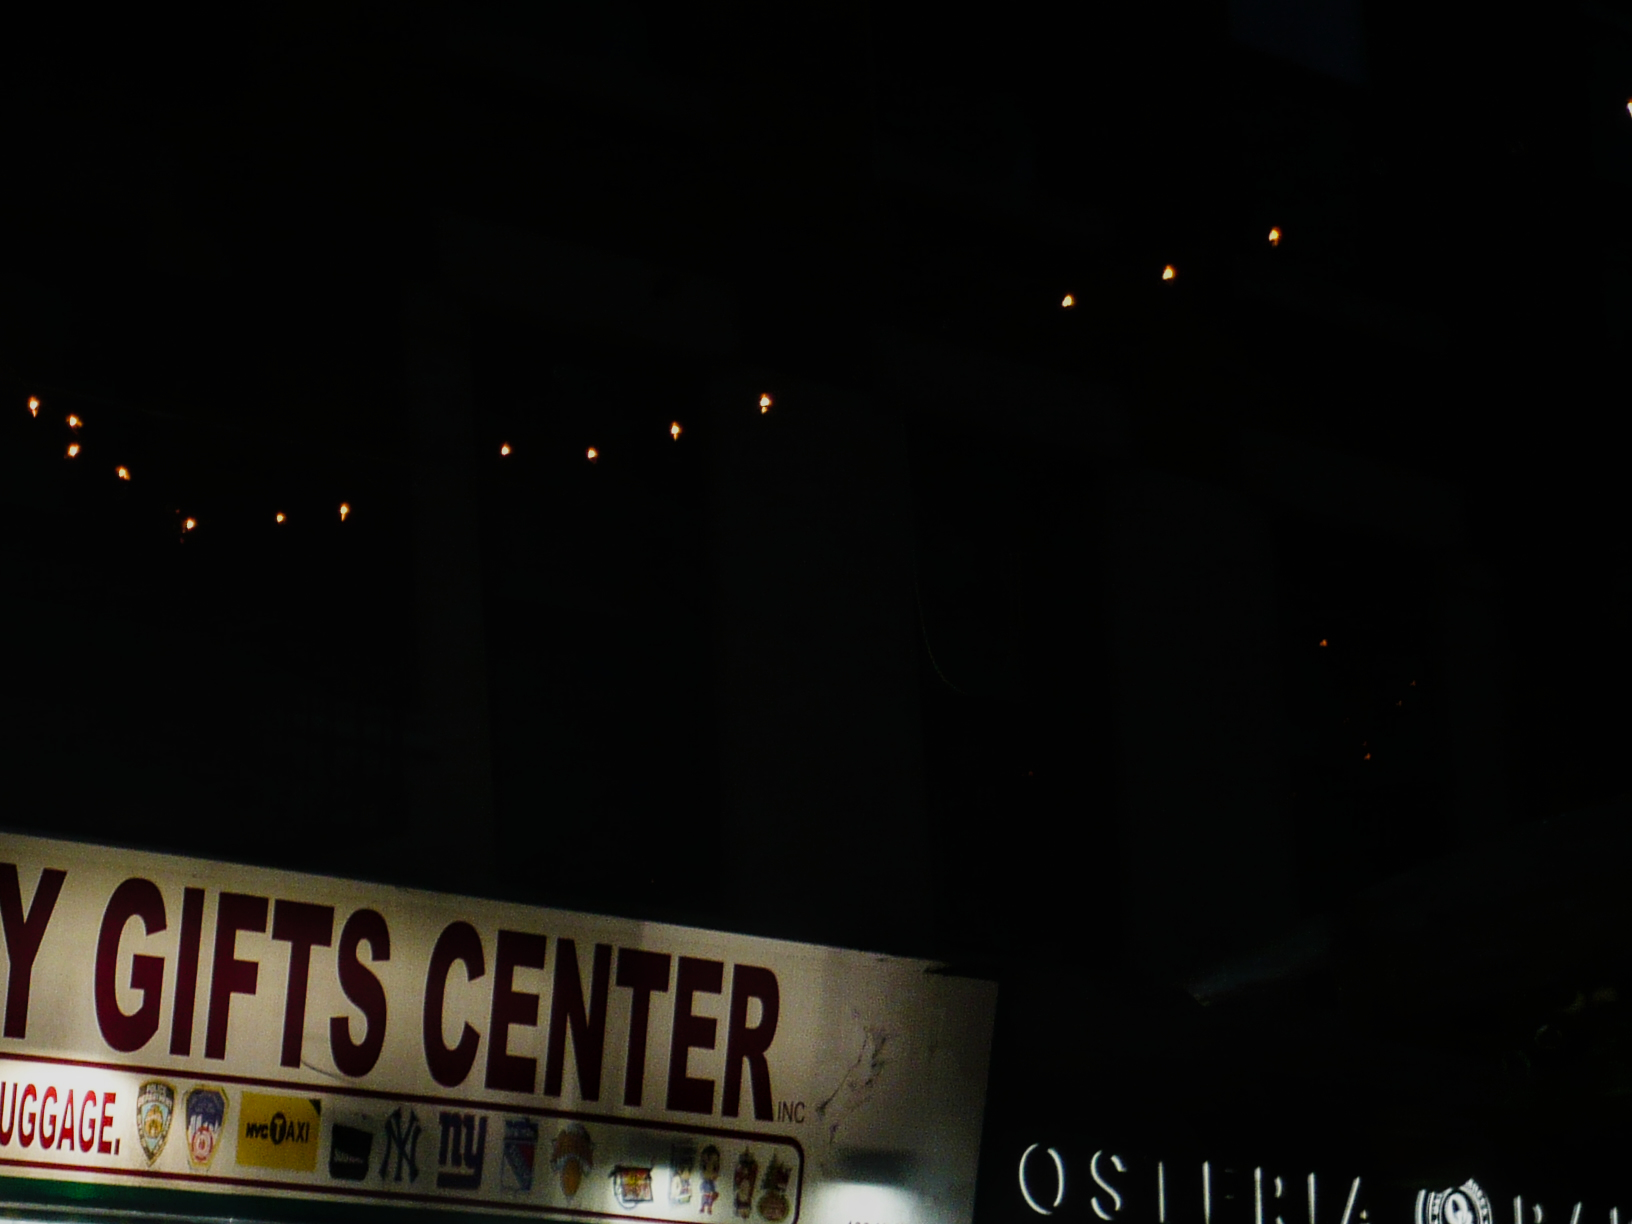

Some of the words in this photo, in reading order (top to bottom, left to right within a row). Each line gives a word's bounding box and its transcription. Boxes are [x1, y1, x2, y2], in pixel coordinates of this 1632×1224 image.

[93, 876, 391, 1078] GIFTS
[423, 920, 780, 1122] CENTER
[777, 1101, 806, 1124] INC
